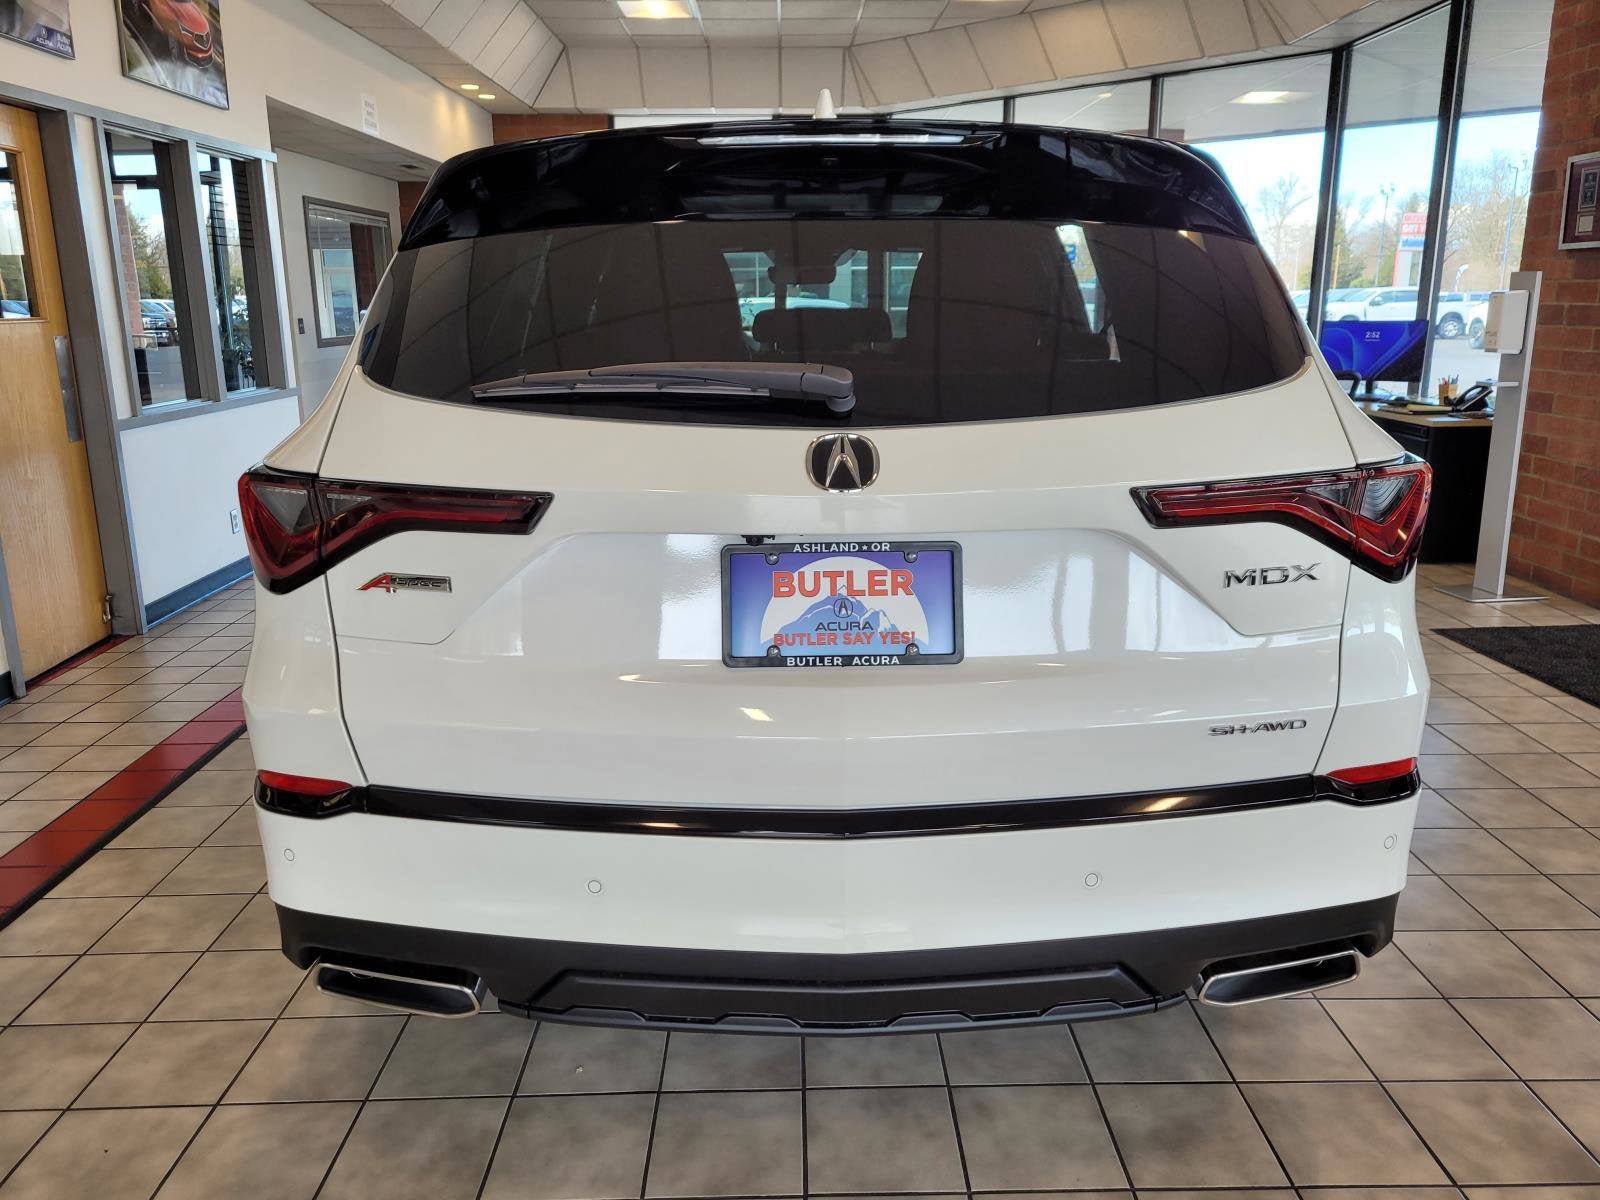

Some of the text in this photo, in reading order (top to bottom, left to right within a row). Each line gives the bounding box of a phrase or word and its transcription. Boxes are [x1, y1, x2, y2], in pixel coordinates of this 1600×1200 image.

[1365, 331, 1380, 339] 2:52
[793, 542, 891, 553] ASHLAND OR
[1223, 562, 1321, 589] MDX
[772, 569, 914, 599] BUTLER
[814, 621, 875, 632] ACURA
[773, 631, 916, 647] BUTLER SAY YES!
[786, 655, 900, 667] BUTLER ACURA
[1208, 719, 1307, 736] SH-AWD
